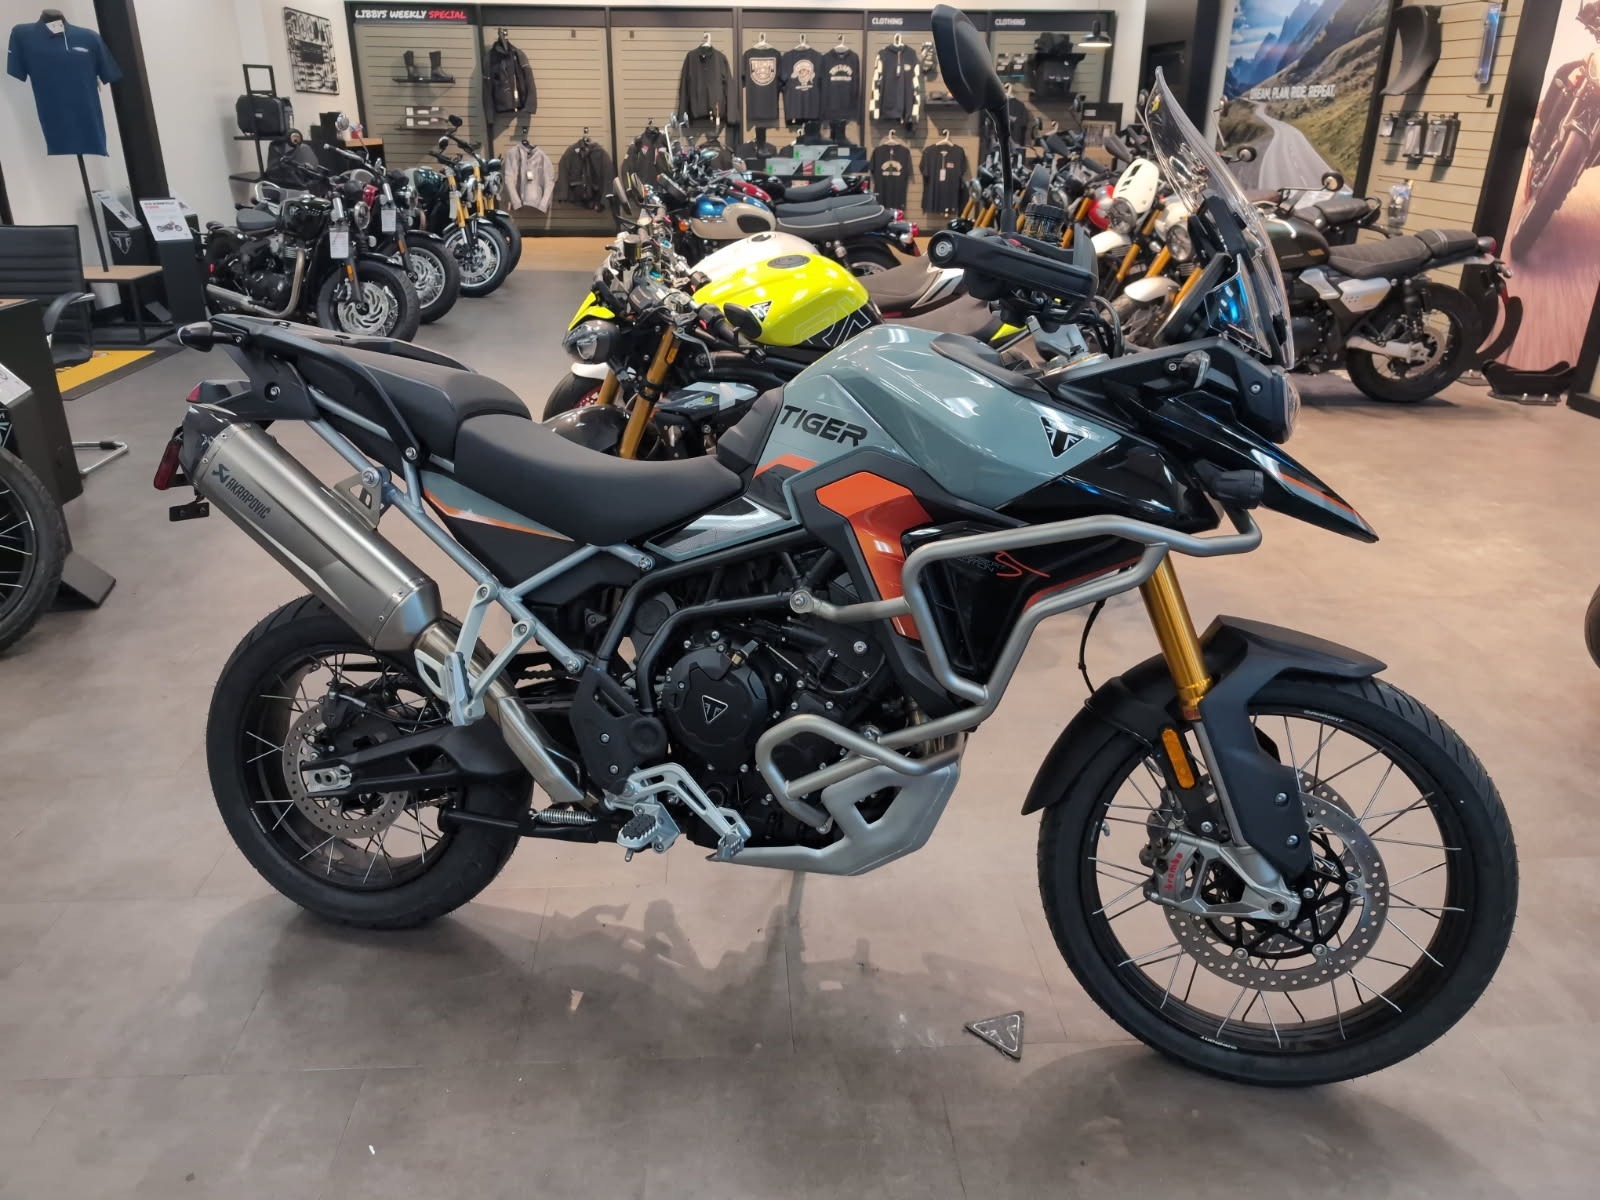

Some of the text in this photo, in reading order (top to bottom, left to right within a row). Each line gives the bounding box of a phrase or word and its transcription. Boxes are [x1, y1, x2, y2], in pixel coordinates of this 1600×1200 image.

[355, 9, 467, 19] LIBBYS WEEKLY SPECIAL
[872, 17, 903, 25] CLOTHING
[994, 17, 1026, 26] CLOTHING
[780, 404, 868, 448] TIGER
[1163, 852, 1184, 890] brembo
